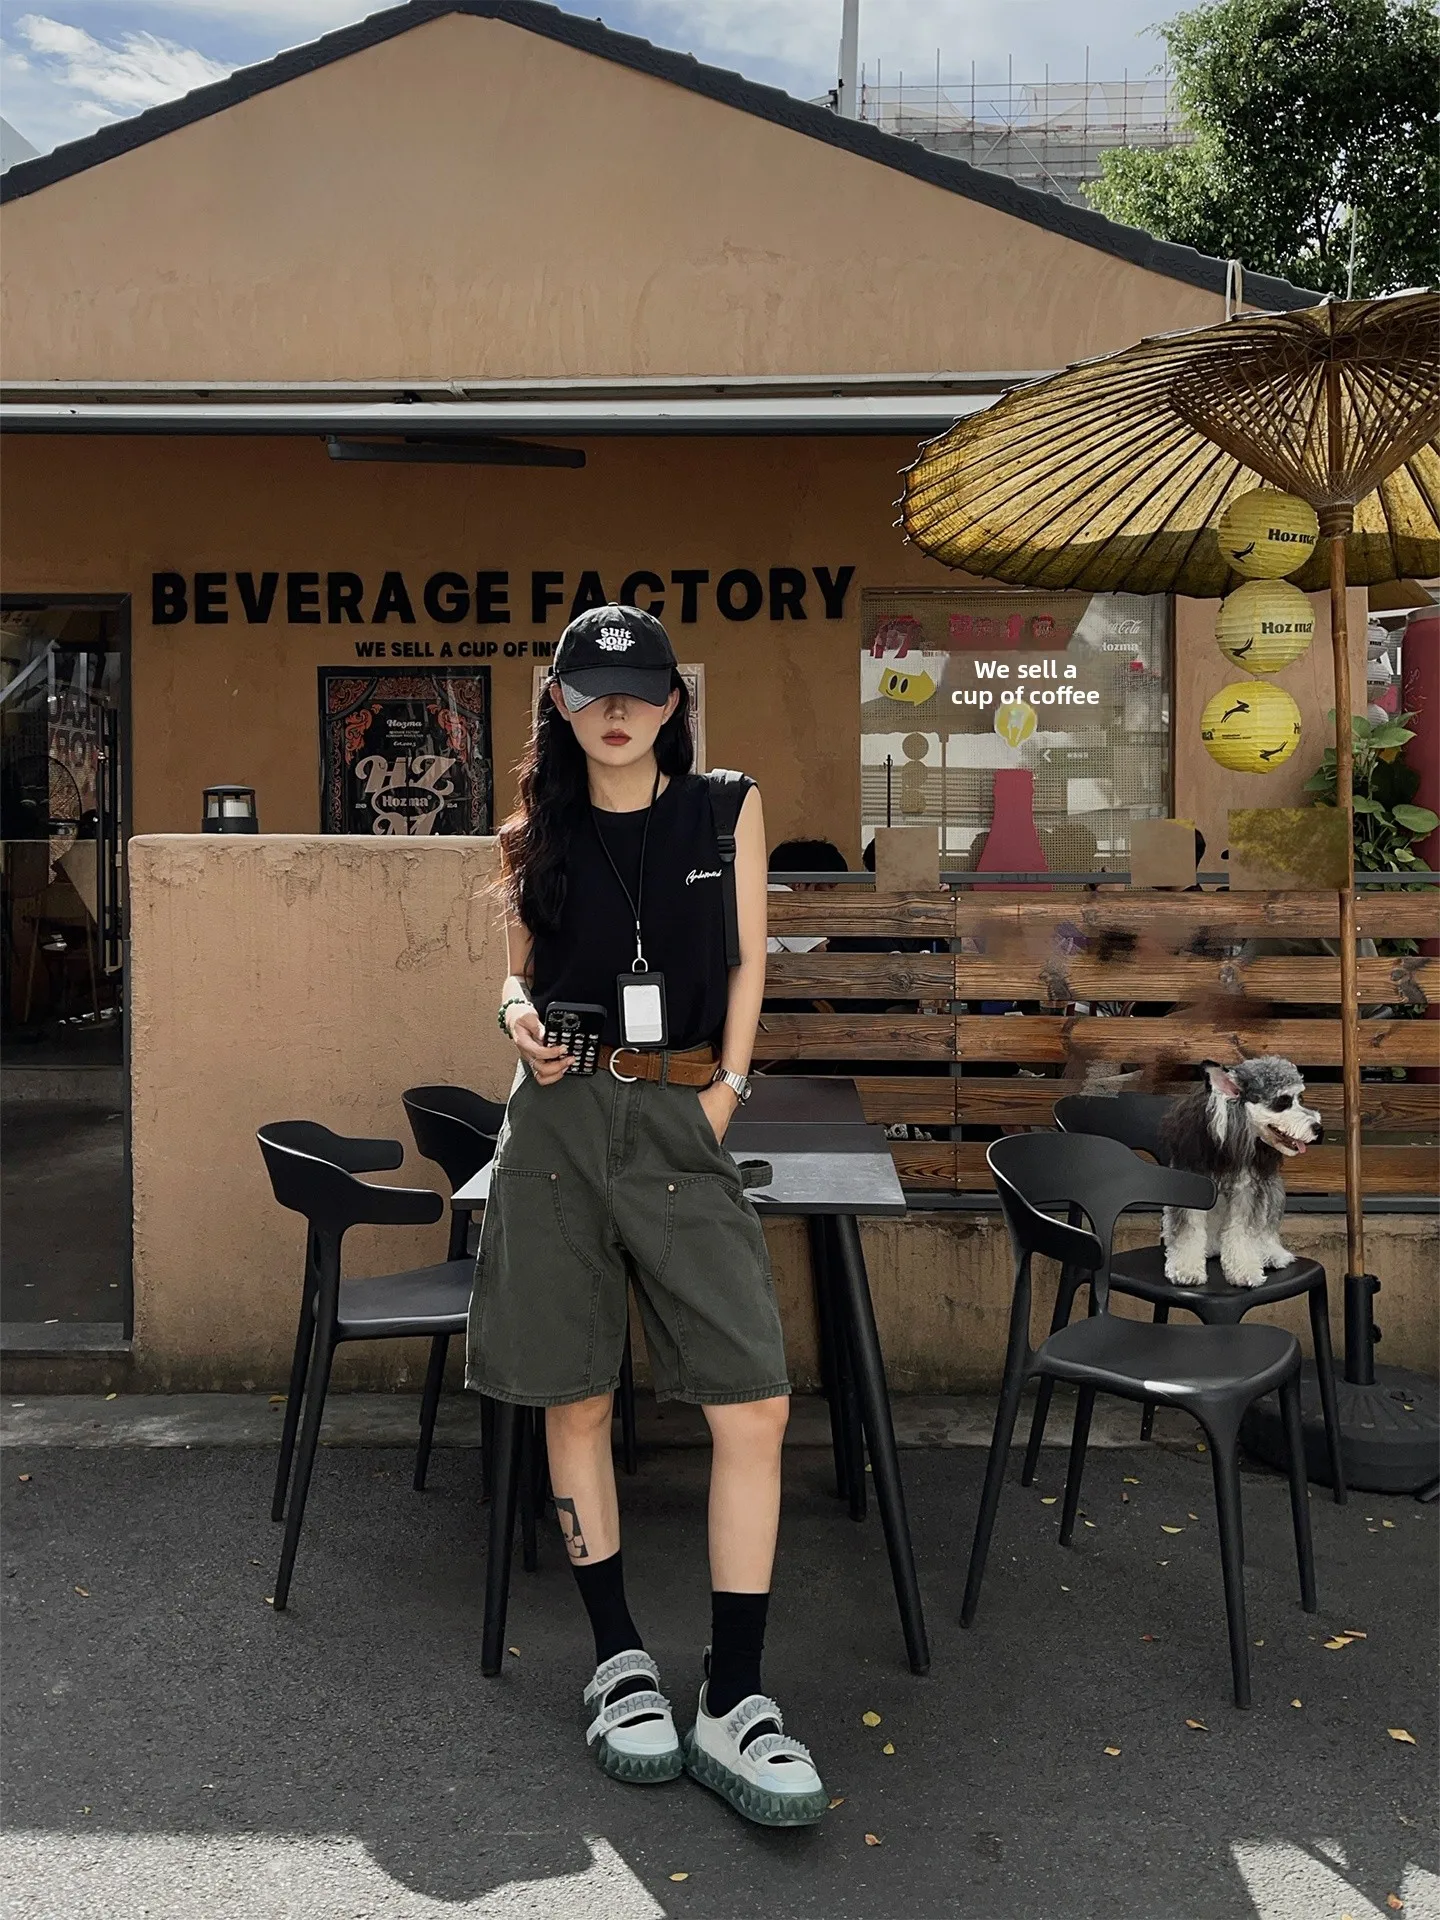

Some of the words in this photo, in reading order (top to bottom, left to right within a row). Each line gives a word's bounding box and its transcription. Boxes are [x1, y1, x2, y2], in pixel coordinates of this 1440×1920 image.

[152, 571, 510, 625] BEVERAGE
[531, 565, 856, 624] FACTORY
[600, 627, 631, 639] suit
[1261, 621, 1313, 635] Hozma
[355, 641, 386, 657] WE
[391, 641, 434, 658] SELL
[440, 641, 453, 657] A
[458, 641, 498, 657] CUP
[503, 641, 528, 657] OF
[595, 636, 636, 650] your
[382, 795, 429, 807] Hozma
